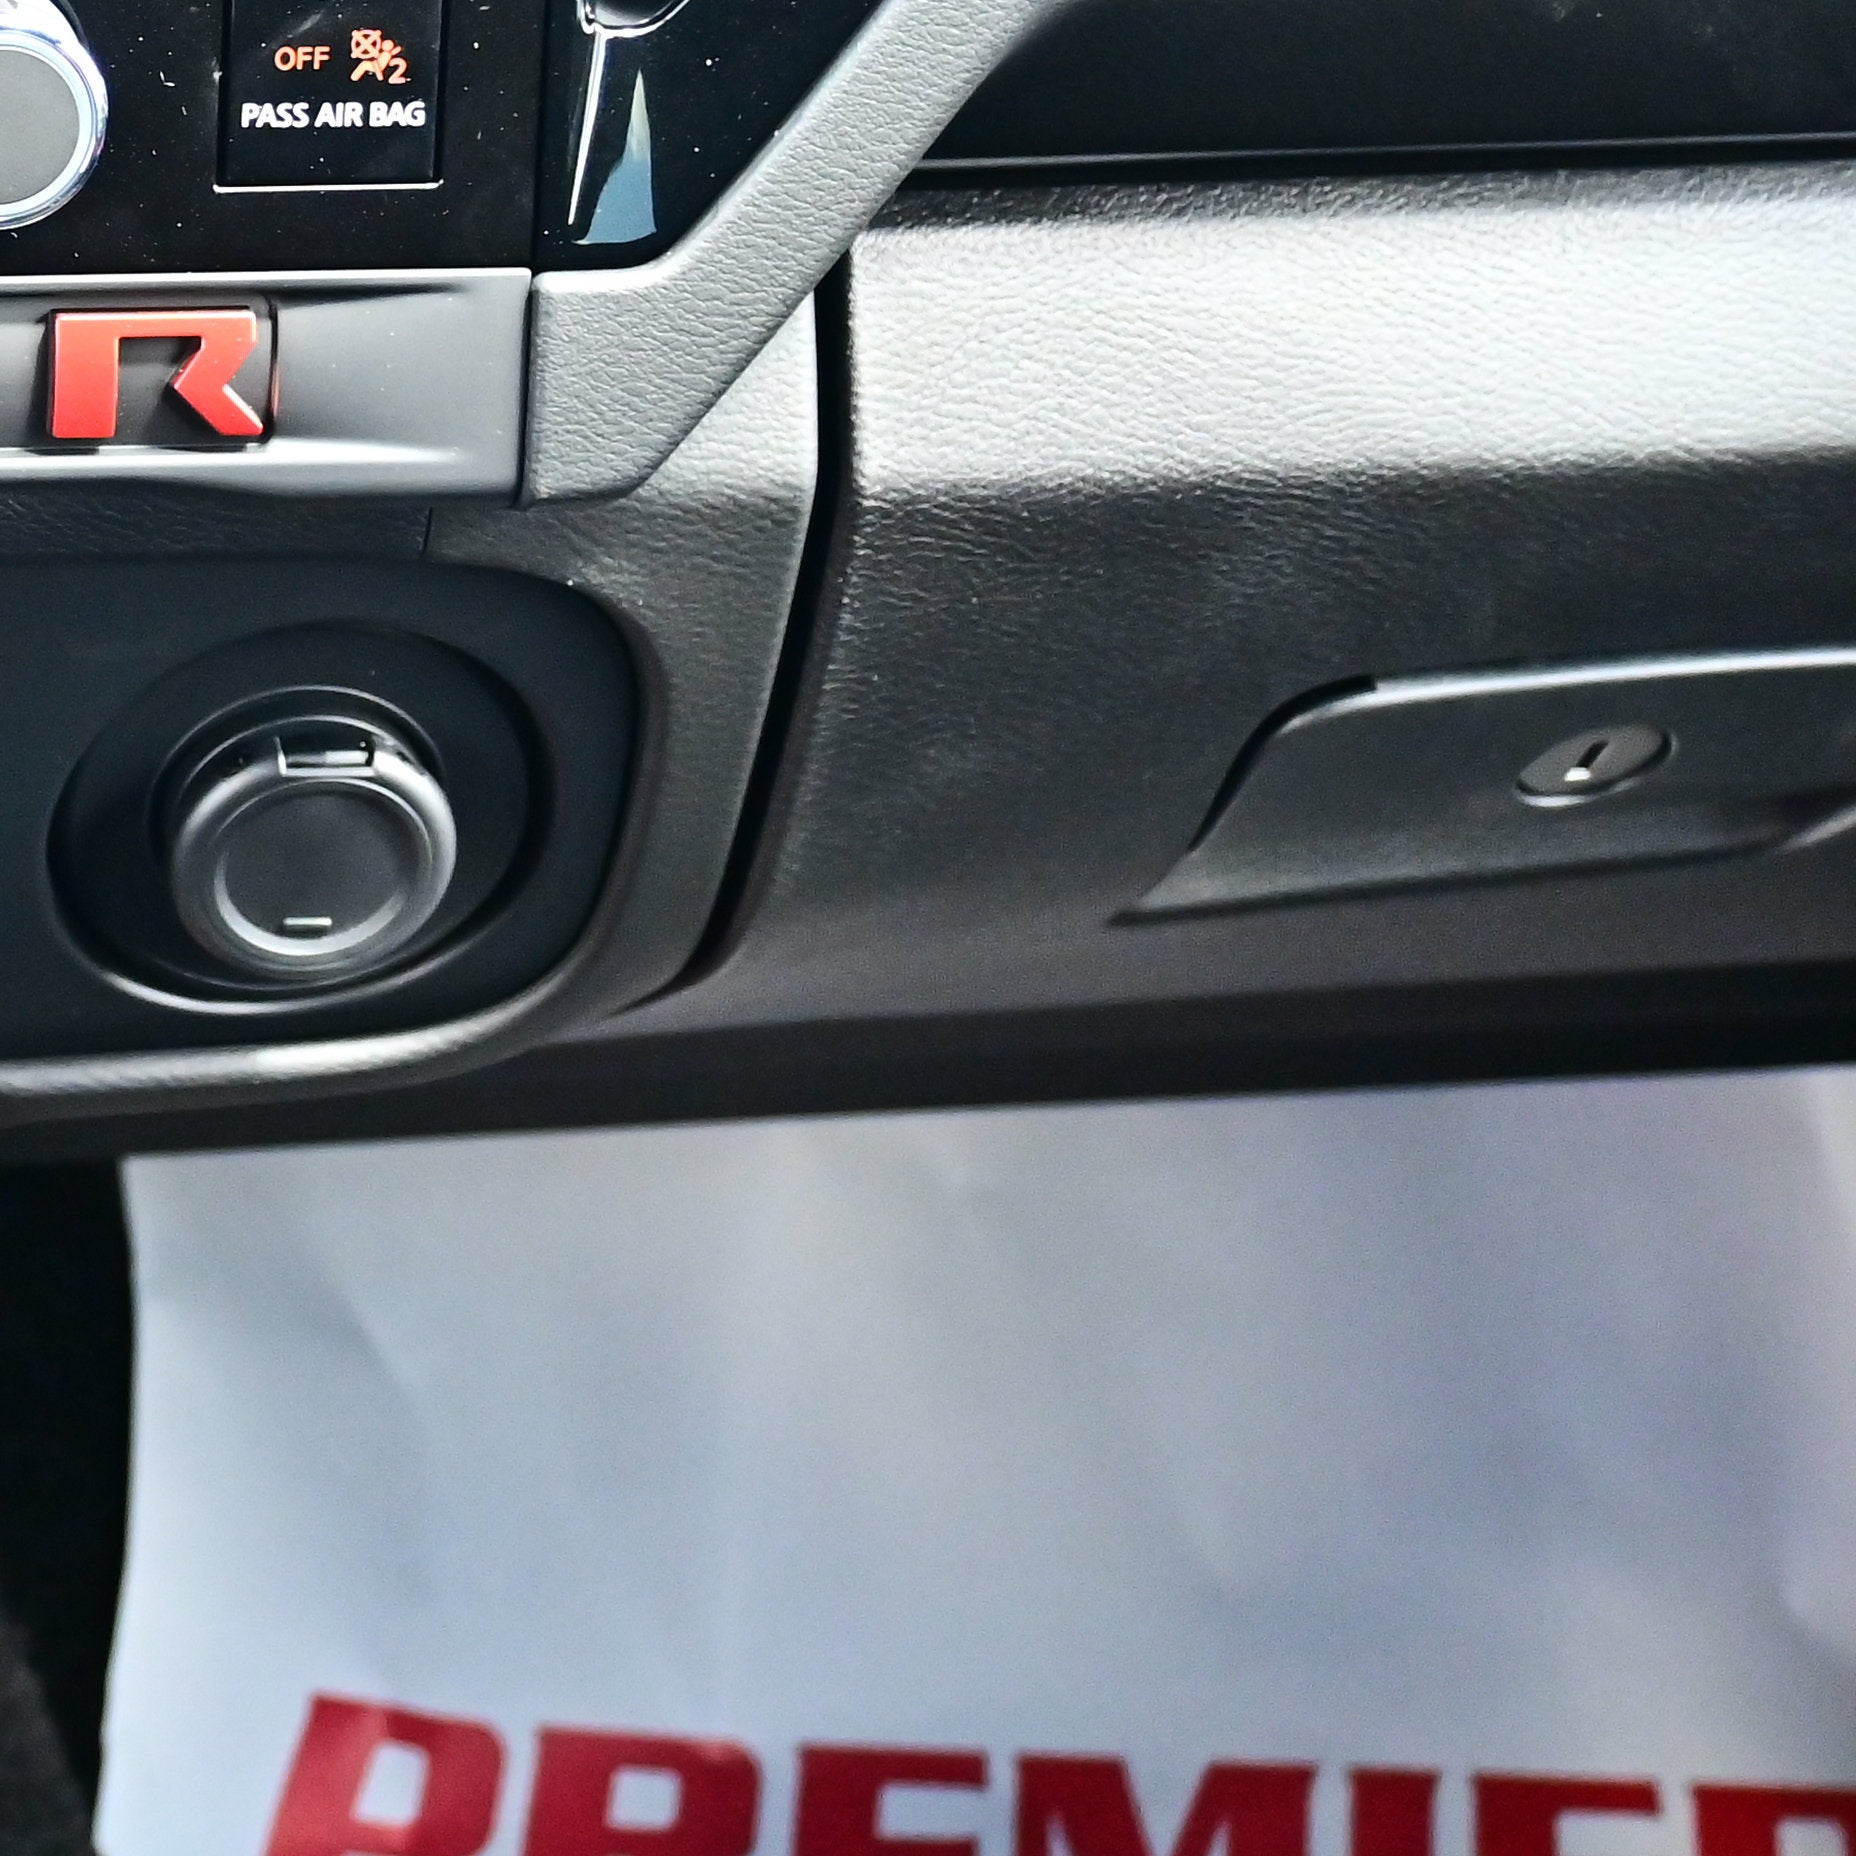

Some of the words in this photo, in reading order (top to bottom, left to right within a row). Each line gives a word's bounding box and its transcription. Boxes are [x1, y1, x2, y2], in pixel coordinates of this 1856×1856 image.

[274, 45, 331, 71] OFF
[240, 101, 310, 129] PASS
[313, 101, 364, 128] AIR
[368, 100, 427, 128] BAG
